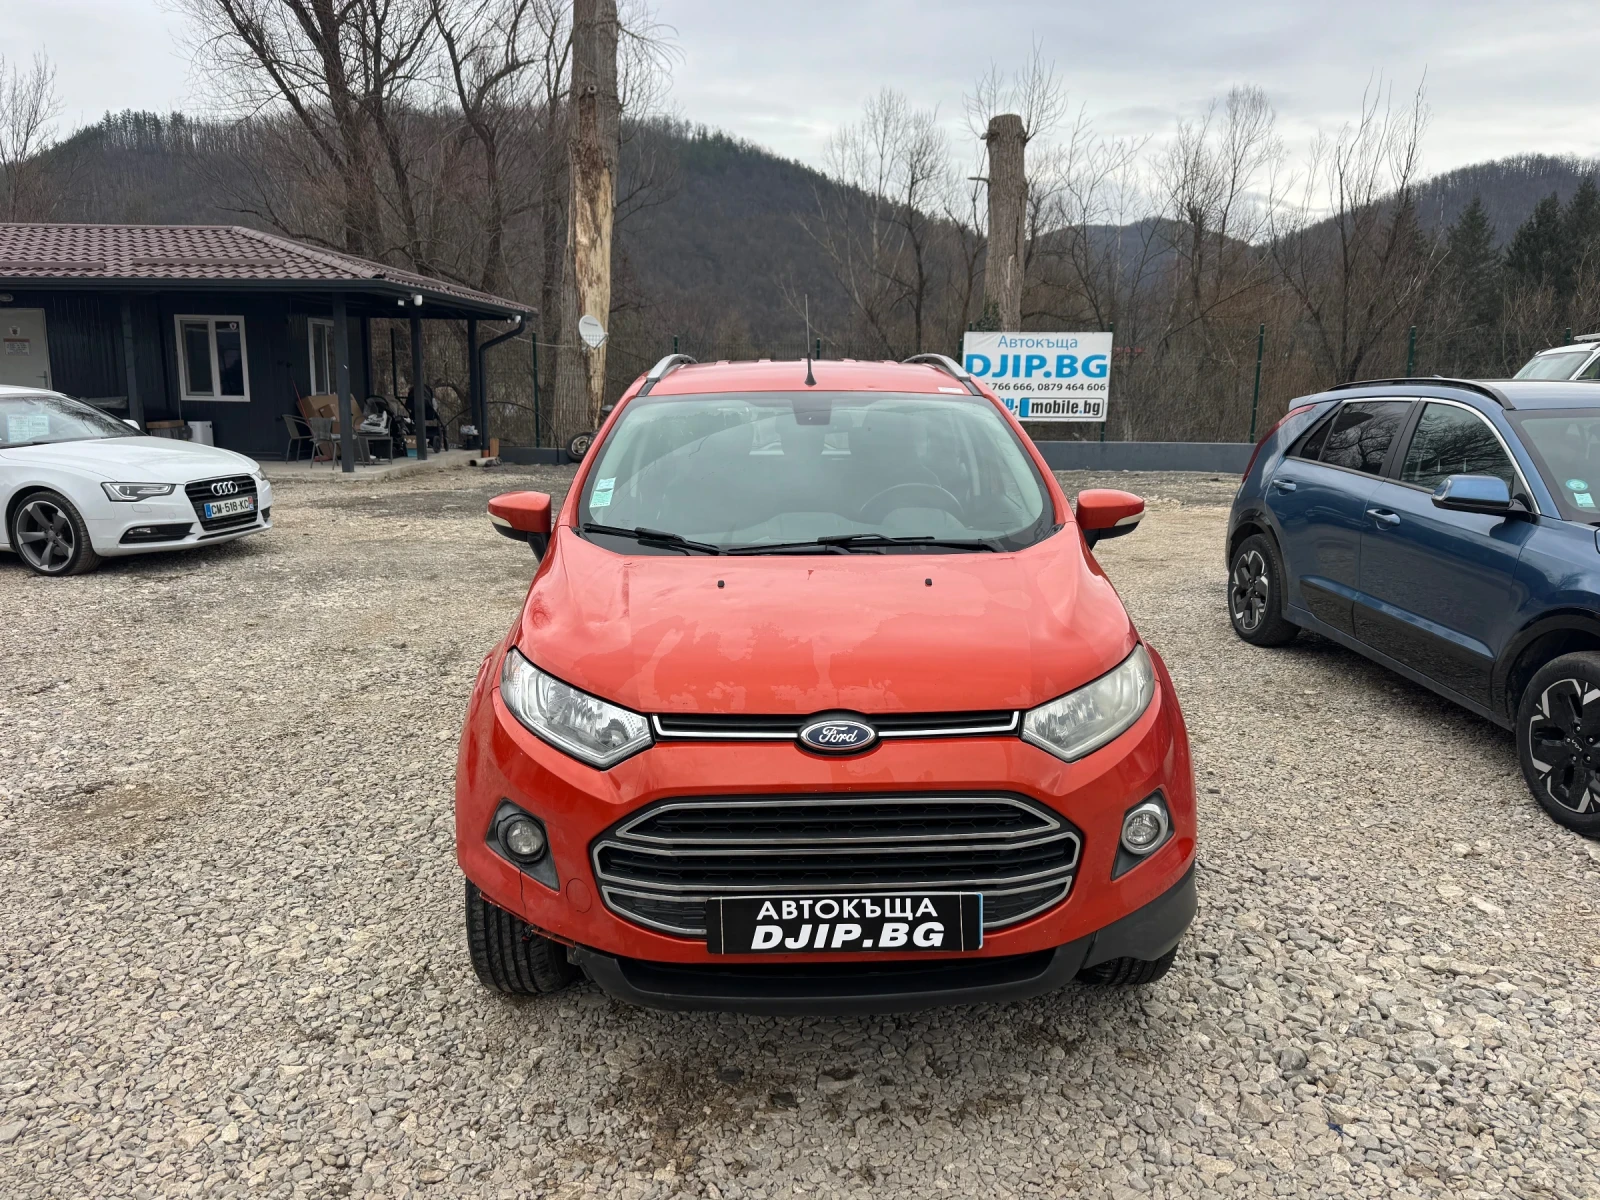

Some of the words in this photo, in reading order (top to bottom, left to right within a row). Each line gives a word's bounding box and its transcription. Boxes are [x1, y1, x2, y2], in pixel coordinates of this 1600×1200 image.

[997, 335, 1078, 350] Автокъща
[965, 353, 1108, 379] DJIP.BG
[992, 382, 1011, 391] 766
[1012, 382, 1035, 392] 666,
[1037, 382, 1063, 391] 0879
[1065, 382, 1084, 391] 464
[1086, 382, 1106, 391] 606
[1031, 400, 1101, 416] mobile.bg
[819, 726, 858, 743] Ford
[756, 897, 938, 921] АВТОКЪЩА
[750, 921, 945, 950] DJIP.BG
